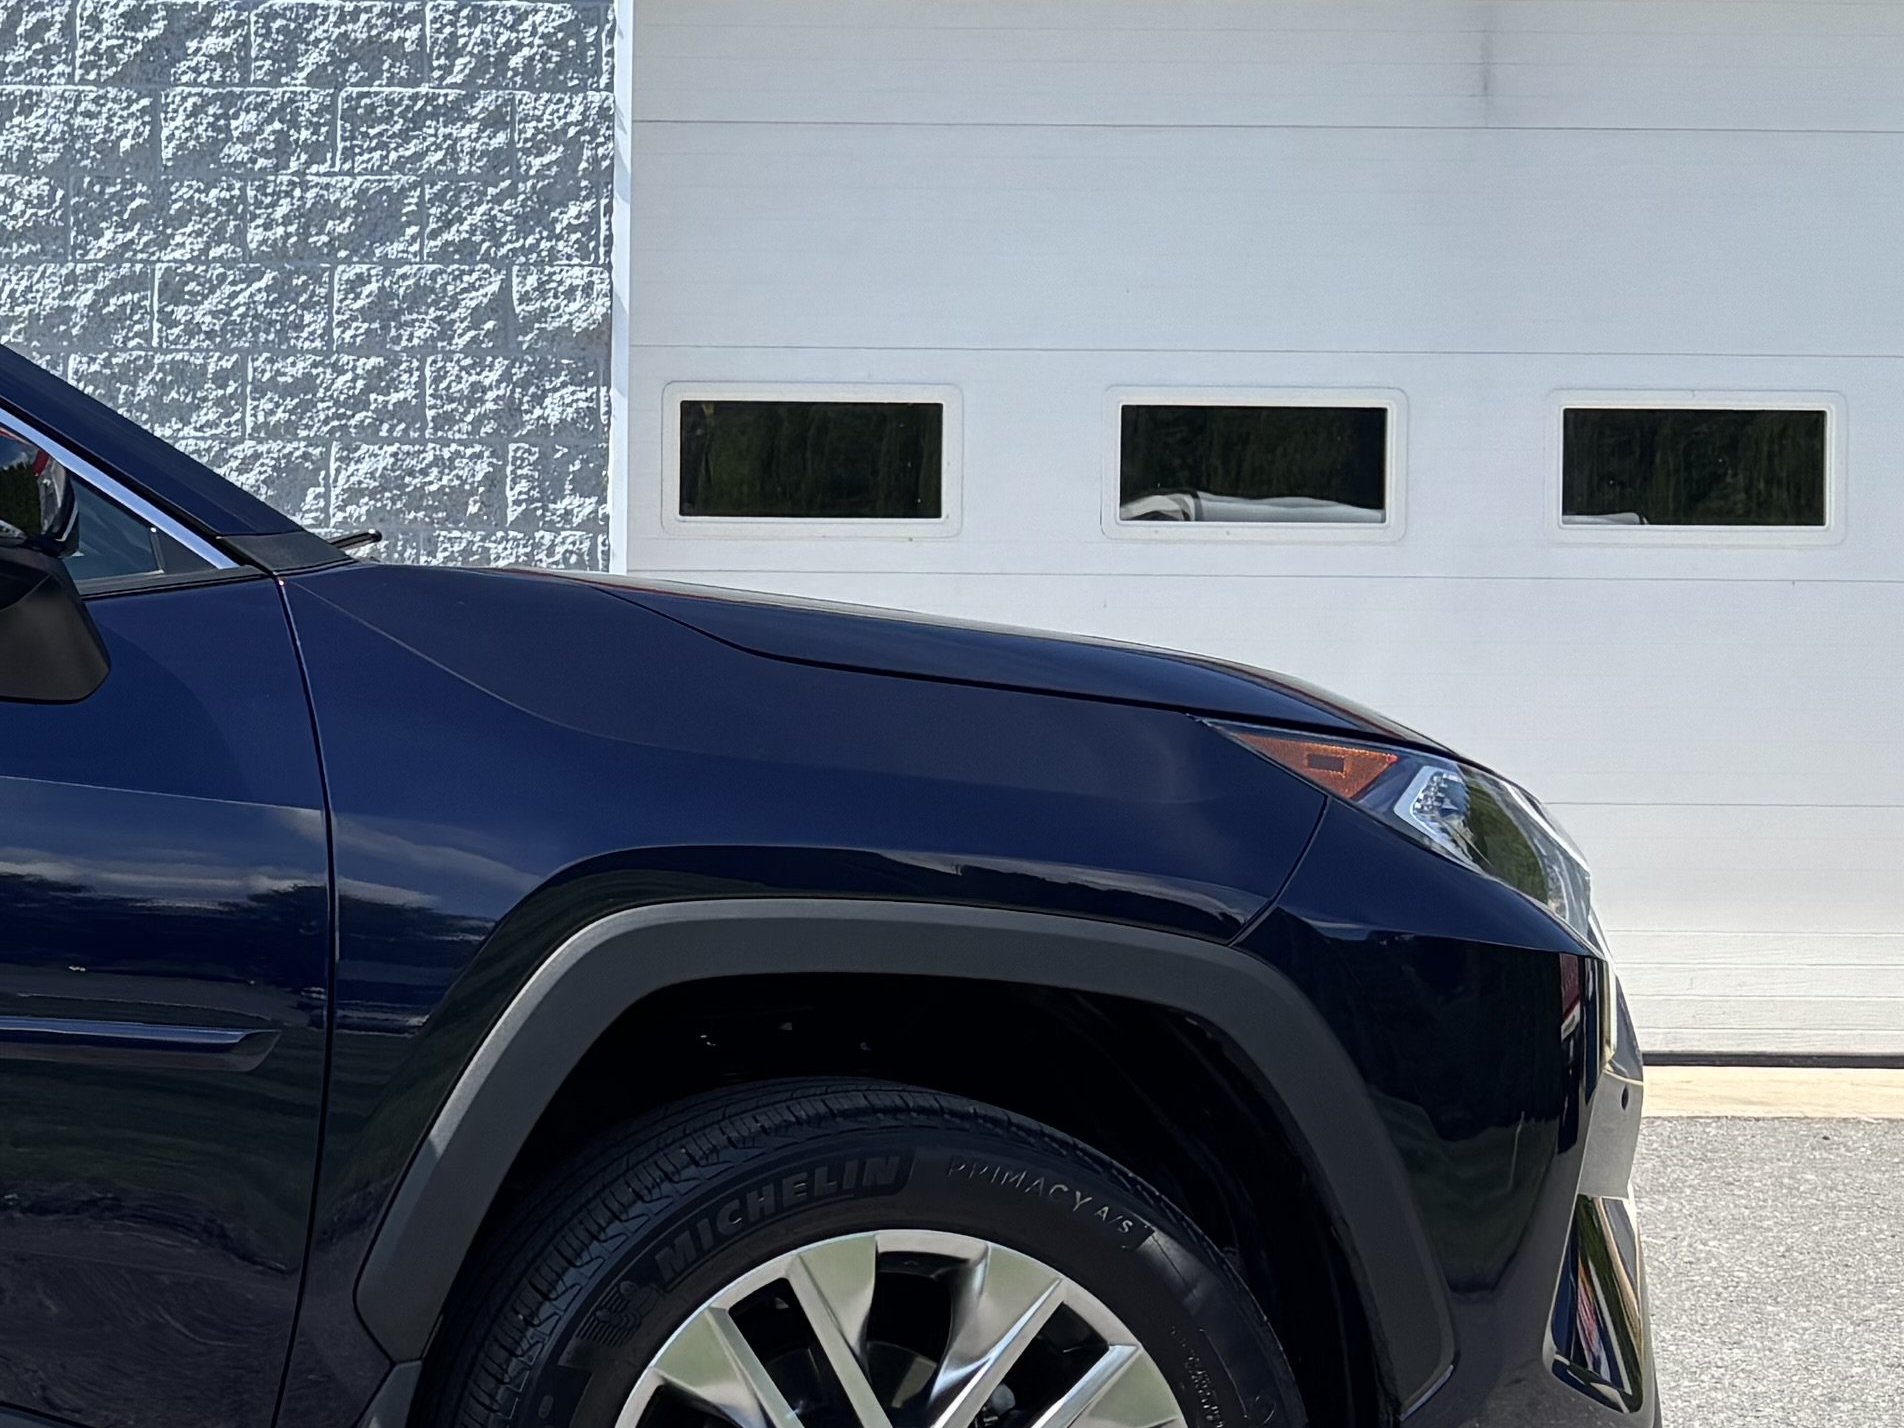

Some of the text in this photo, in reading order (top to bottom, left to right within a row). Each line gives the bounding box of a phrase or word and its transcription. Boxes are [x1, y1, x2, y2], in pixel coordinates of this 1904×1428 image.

[655, 1155, 901, 1279] MICHELIN
[947, 1161, 1135, 1236] PRIMACY A/S
